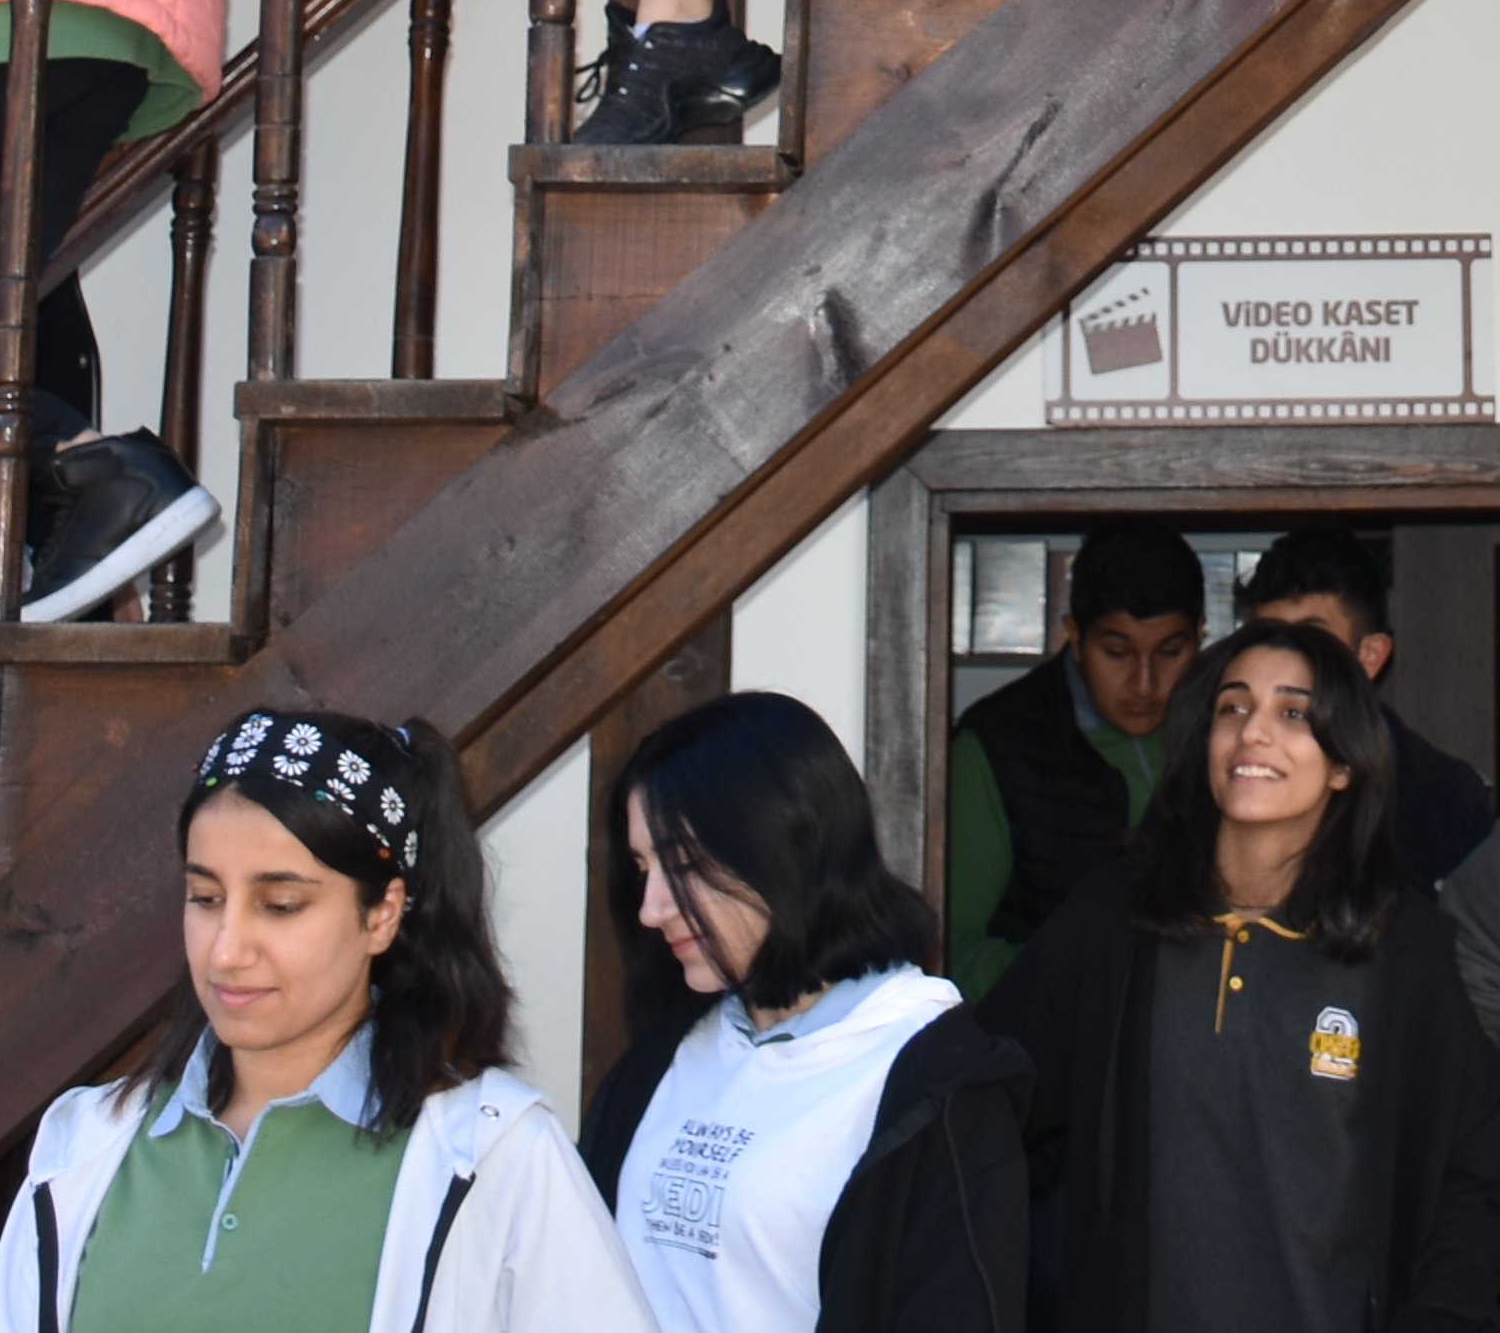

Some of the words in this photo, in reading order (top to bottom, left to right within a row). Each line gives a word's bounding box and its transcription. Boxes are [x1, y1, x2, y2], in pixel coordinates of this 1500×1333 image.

[1222, 300, 1313, 328] VİDEO
[1321, 298, 1420, 327] KASET
[1249, 331, 1392, 365] DÜKKÂNI
[641, 1171, 726, 1228] JEDI
